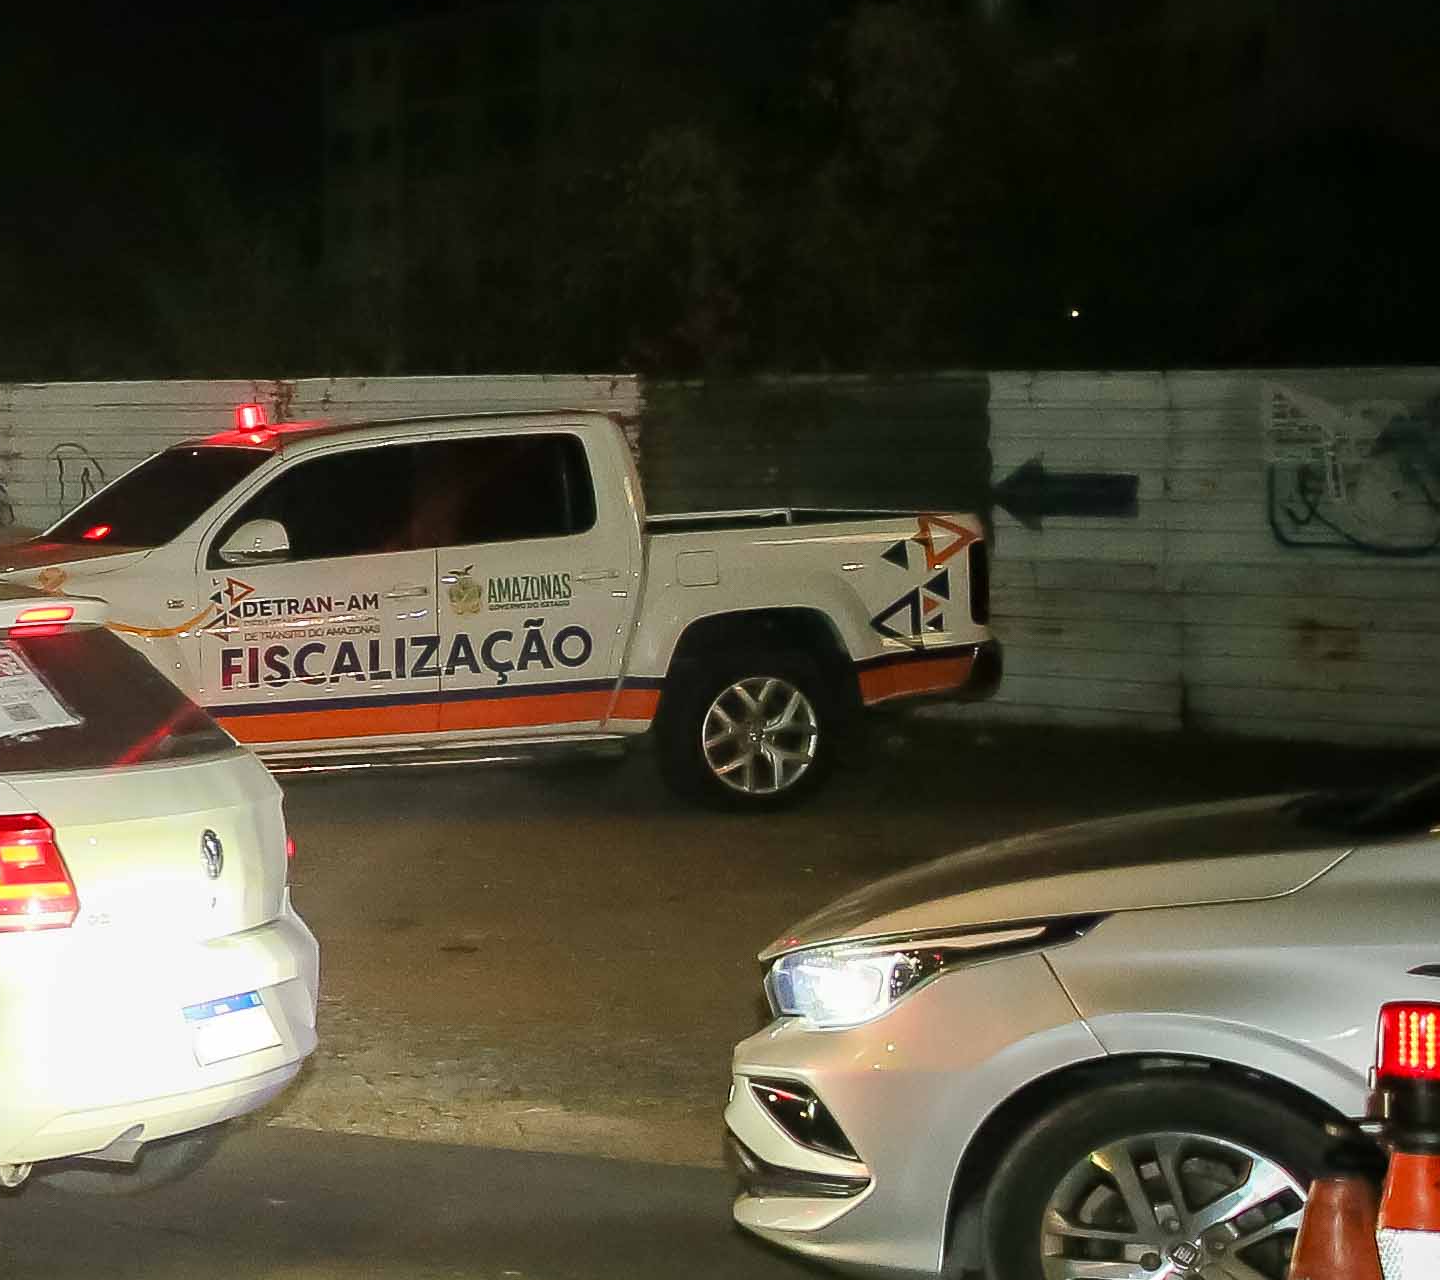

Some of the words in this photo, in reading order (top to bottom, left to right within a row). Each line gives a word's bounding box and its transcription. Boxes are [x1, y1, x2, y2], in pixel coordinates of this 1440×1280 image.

[487, 573, 572, 603] AMAZONAS
[242, 595, 379, 618] DETRAN-AM
[308, 627, 323, 638] DO
[326, 625, 381, 636] AMAZONAS
[221, 618, 593, 691] FISCALIZAÇÃO
